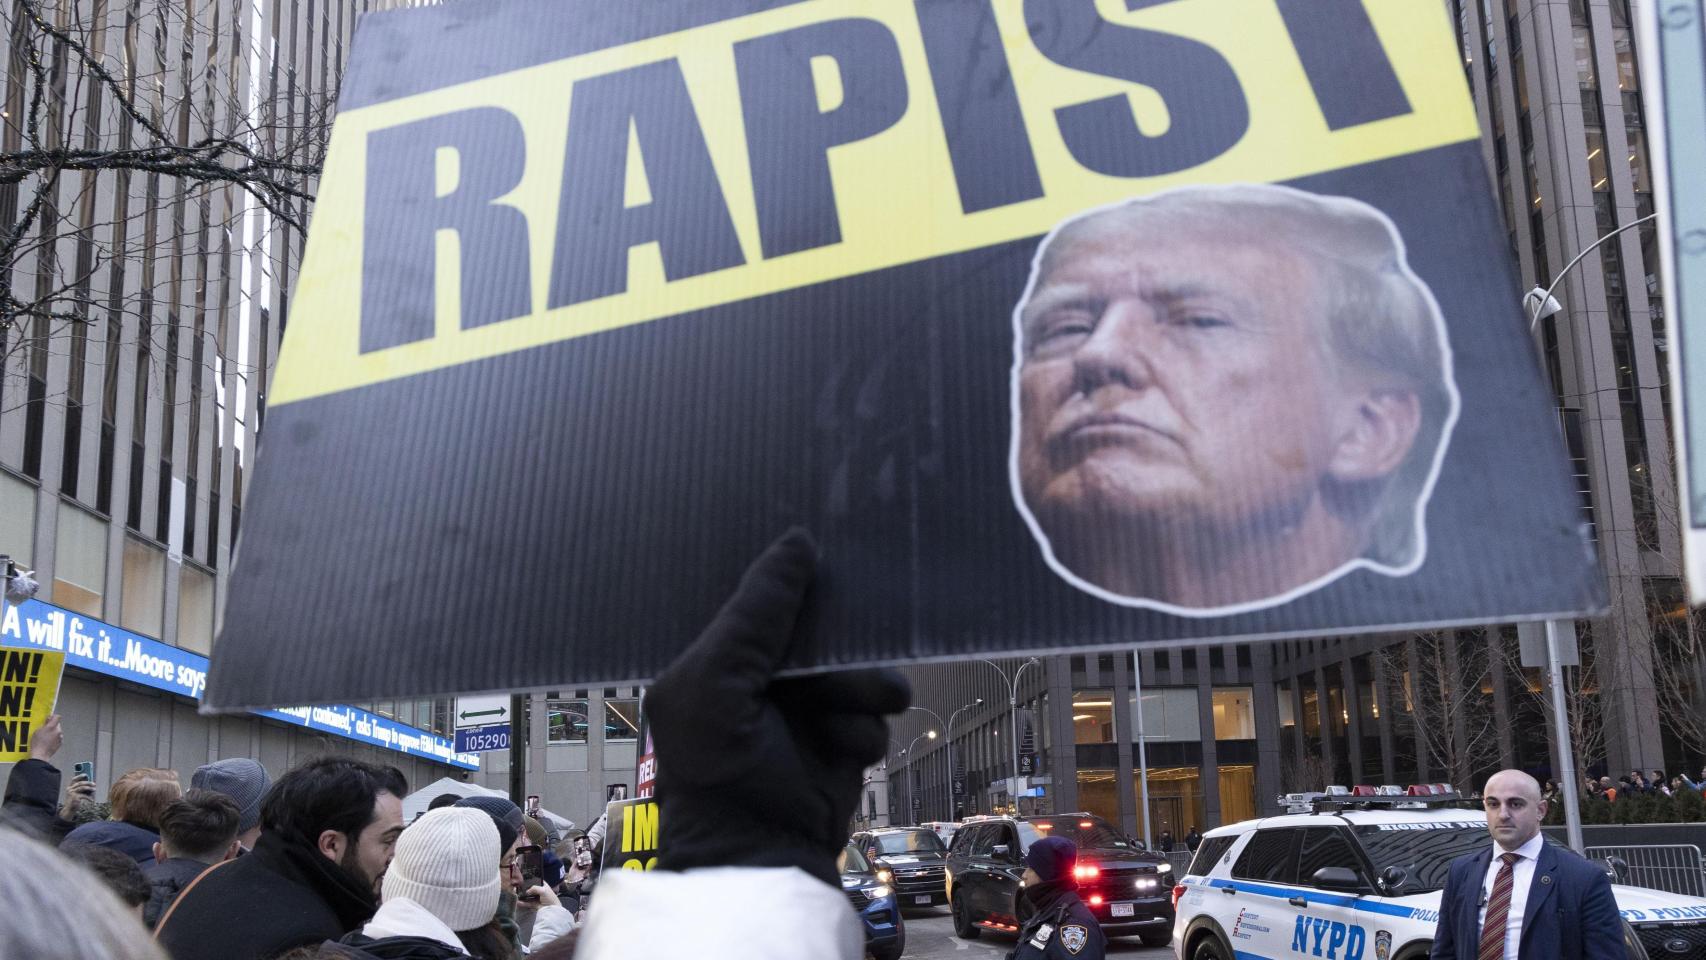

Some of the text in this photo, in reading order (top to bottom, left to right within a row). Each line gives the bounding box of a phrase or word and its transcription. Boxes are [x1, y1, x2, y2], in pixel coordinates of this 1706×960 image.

[26, 610, 66, 651] will
[68, 617, 94, 659] fix
[176, 664, 207, 697] says
[356, 712, 372, 737] asks
[372, 718, 391, 748] Trump
[465, 733, 507, 751] 105290
[621, 802, 659, 853] IM
[1377, 821, 1455, 831] HIGHWAY
[1292, 914, 1366, 960] NYPD
